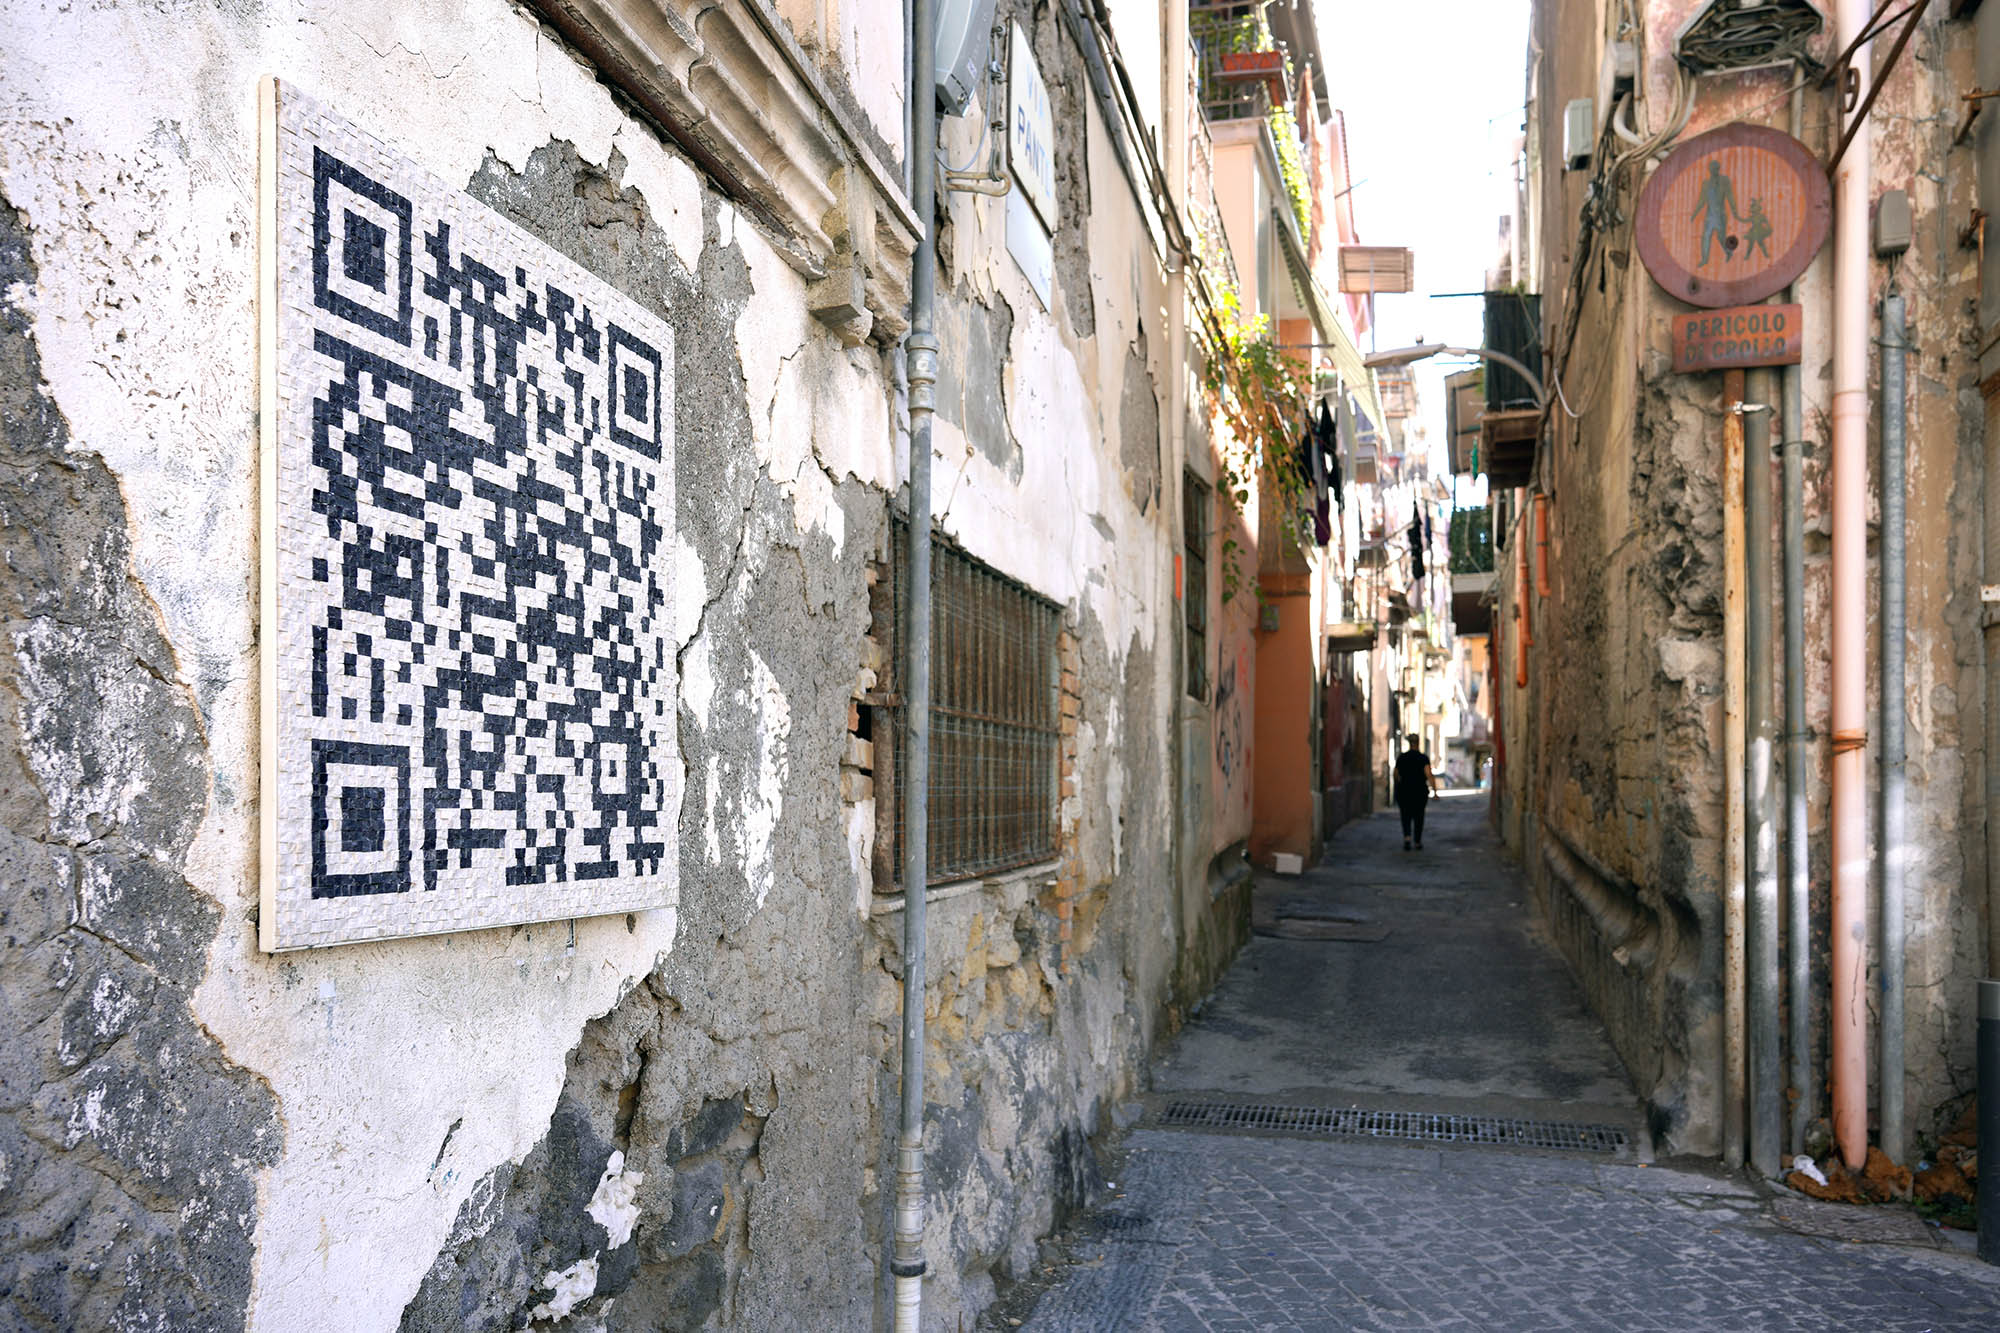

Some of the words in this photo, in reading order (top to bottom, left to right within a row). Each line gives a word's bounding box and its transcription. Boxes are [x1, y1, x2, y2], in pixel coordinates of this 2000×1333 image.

[1686, 312, 1785, 341] PERICOLO
[1685, 344, 1704, 364] DI
[1712, 337, 1786, 360] CROLLO
